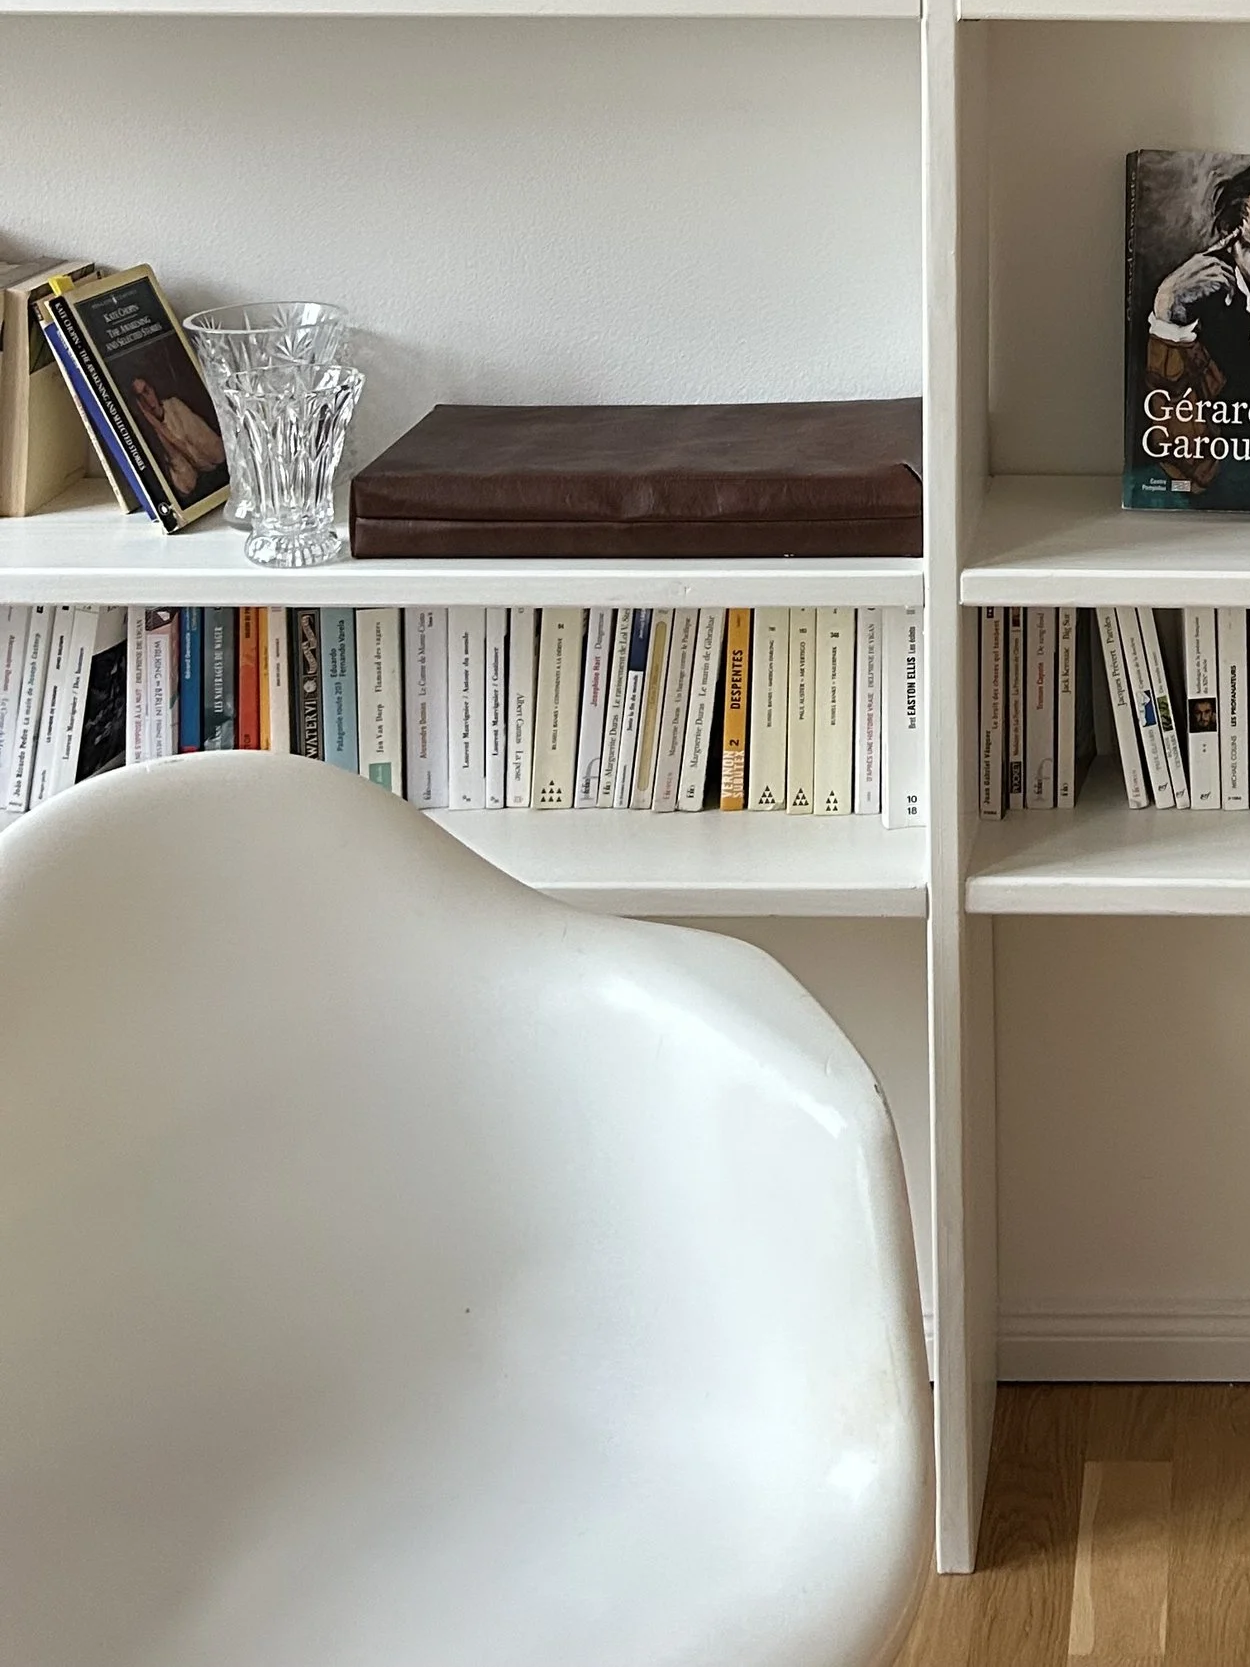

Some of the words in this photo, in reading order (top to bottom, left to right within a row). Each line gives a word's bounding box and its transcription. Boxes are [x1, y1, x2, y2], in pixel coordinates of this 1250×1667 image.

[907, 656, 916, 679] ELLIS
[729, 649, 743, 709] DESPENTES
[906, 682, 916, 715] EASTON
[906, 717, 915, 728] Bret
[907, 795, 917, 804] 10
[907, 806, 917, 815] 18
